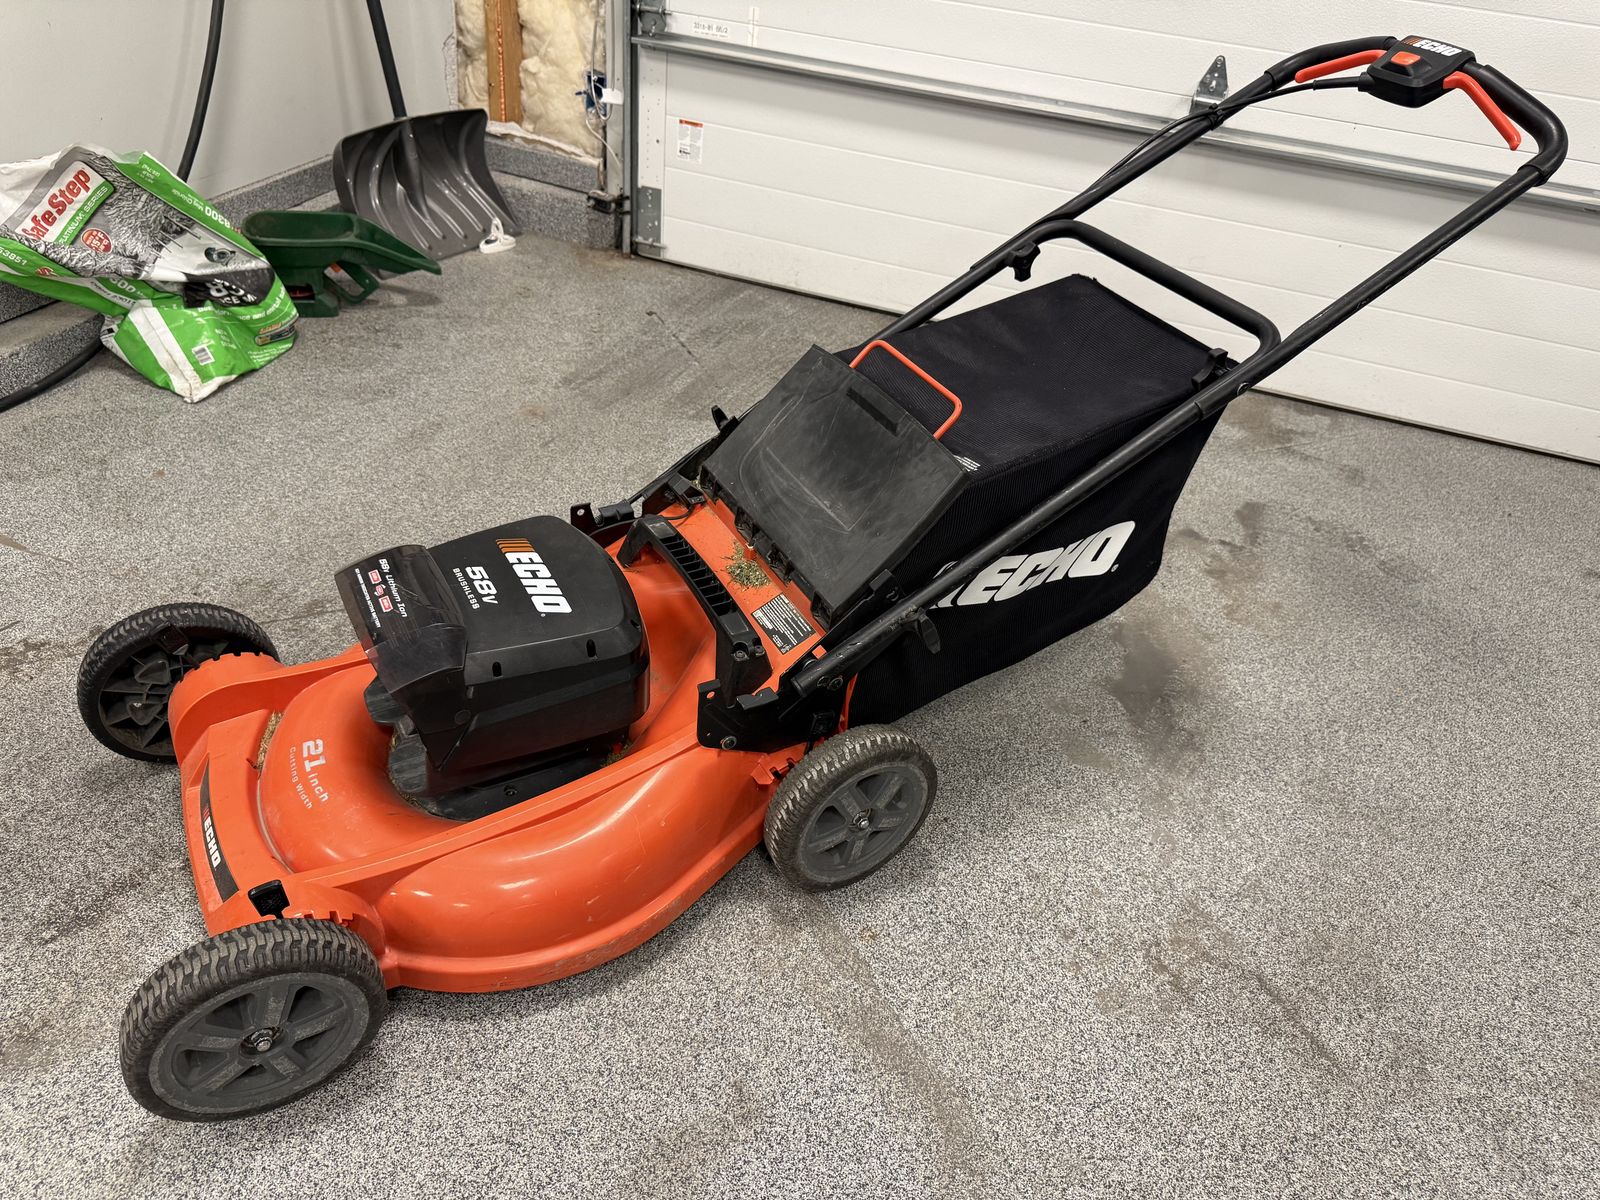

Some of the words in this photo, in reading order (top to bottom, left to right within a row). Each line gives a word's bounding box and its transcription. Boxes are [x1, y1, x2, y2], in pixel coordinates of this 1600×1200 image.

[1413, 39, 1462, 57] ECHO
[84, 186, 108, 212] SERIES
[204, 206, 231, 229] 8300
[504, 551, 573, 614] ECHO
[957, 520, 1136, 606] ECHO
[386, 574, 401, 602] Lithium
[397, 602, 408, 618] Ion
[452, 567, 481, 610] BRUSHLESS
[303, 739, 326, 772] 21
[289, 746, 300, 784] Cutting
[296, 782, 313, 809] Width
[308, 772, 329, 802] inch
[204, 816, 222, 868] ECHO
